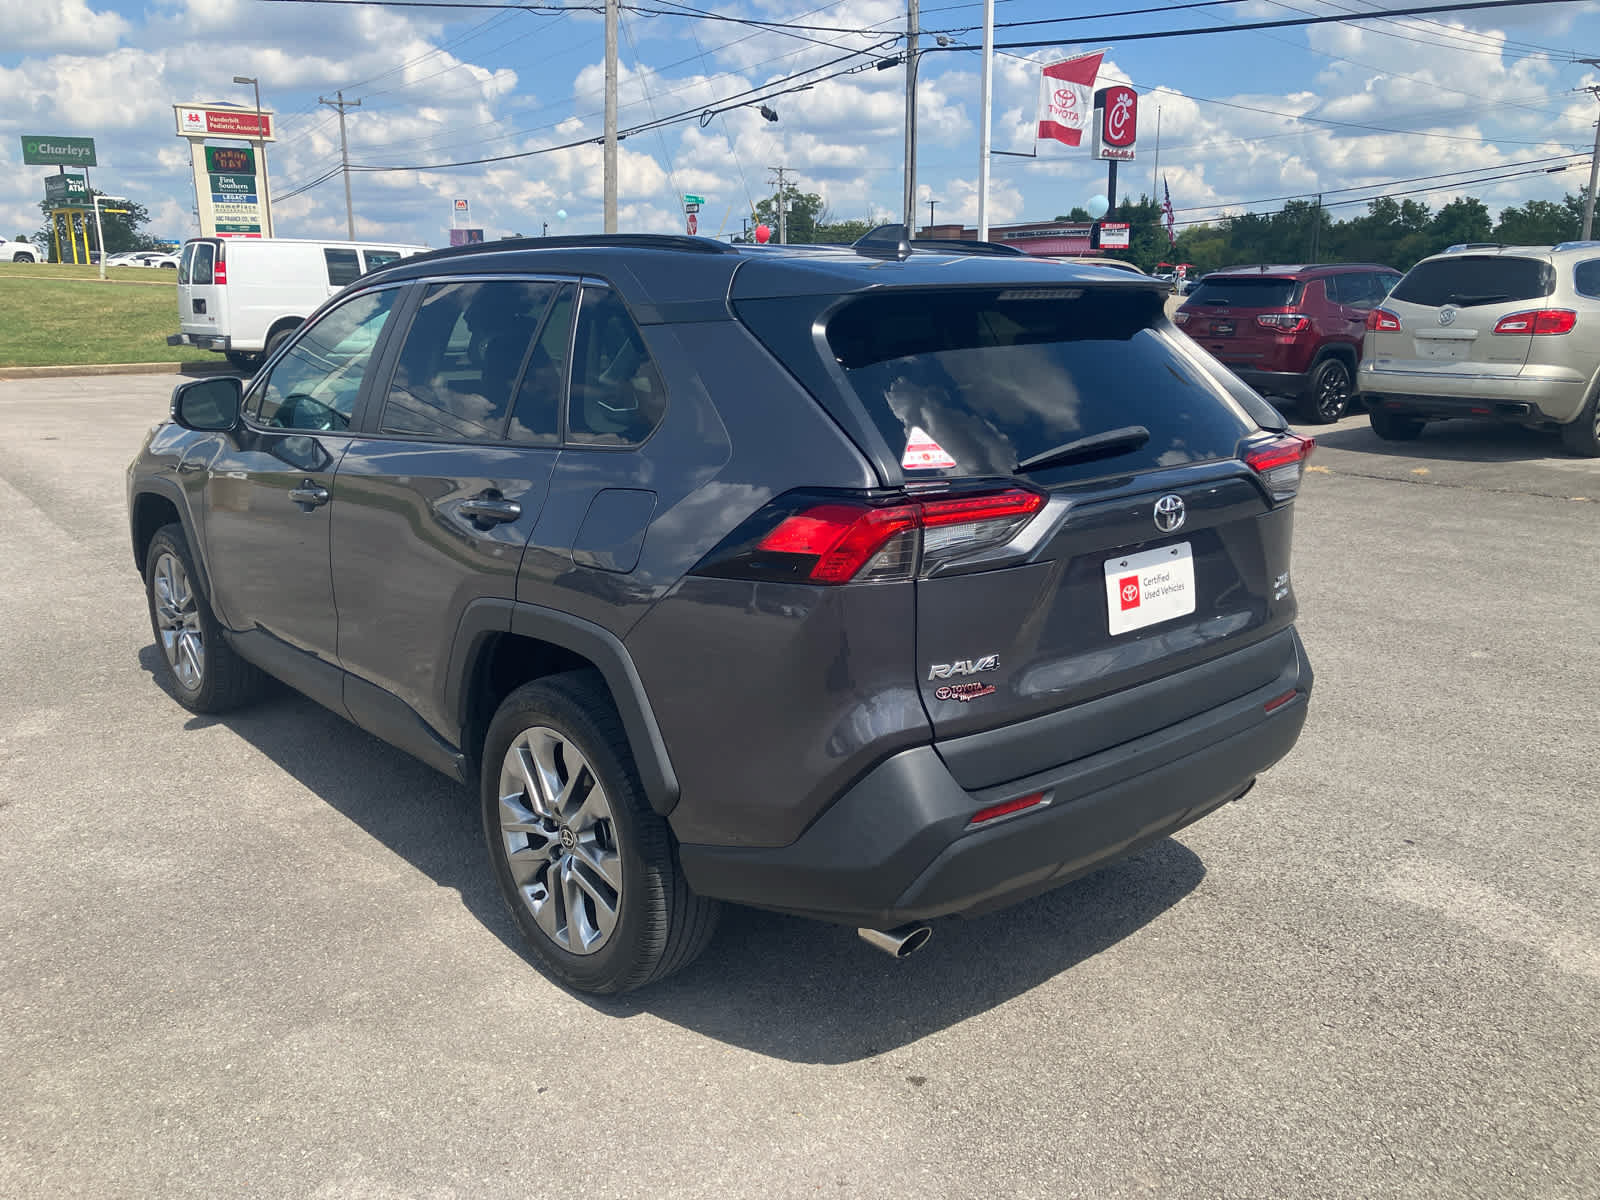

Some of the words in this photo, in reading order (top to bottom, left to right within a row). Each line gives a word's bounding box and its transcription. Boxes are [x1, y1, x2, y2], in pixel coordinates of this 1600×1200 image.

[1048, 104, 1079, 121] TOYOTA
[208, 115, 240, 124] Vanderbilt
[209, 122, 236, 131] Pediatric
[219, 176, 235, 185] First
[68, 185, 85, 193] ATM
[218, 182, 249, 190] Southern
[1143, 573, 1171, 587] Certified
[1144, 587, 1160, 599] Used
[1161, 582, 1185, 597] Vehicles
[928, 654, 1000, 681] RAV4
[951, 682, 983, 693] TOYOTA
